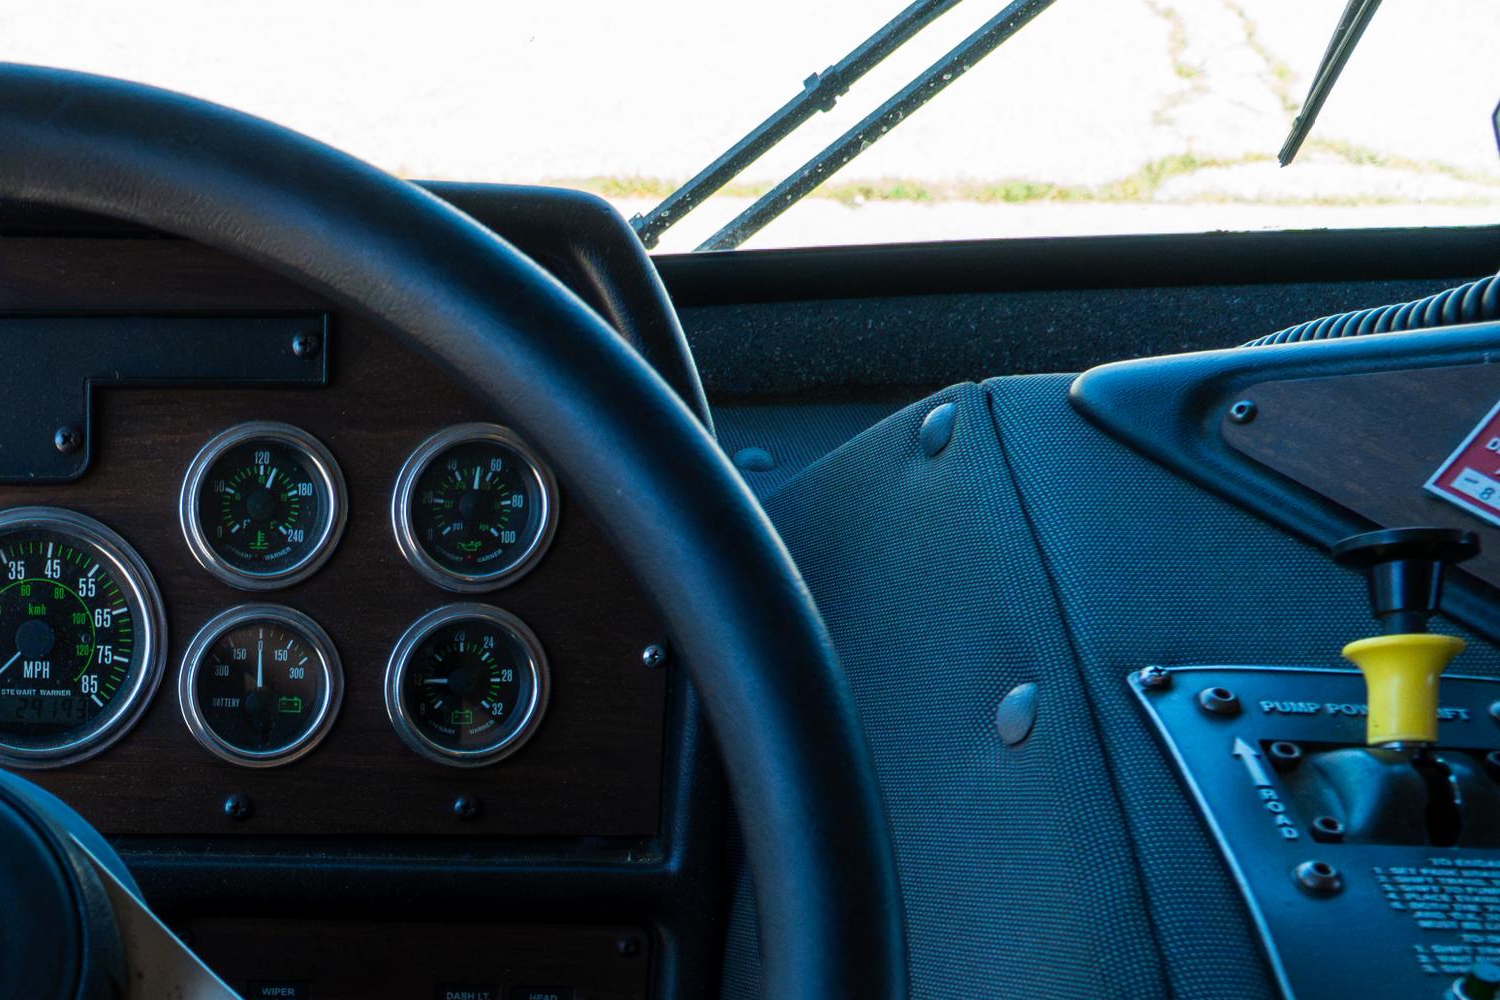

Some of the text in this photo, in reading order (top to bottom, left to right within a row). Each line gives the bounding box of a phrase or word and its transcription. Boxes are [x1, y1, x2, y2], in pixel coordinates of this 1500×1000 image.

[254, 451, 270, 465] 120
[490, 458, 502, 472] 60
[297, 482, 313, 496] 180
[511, 494, 523, 508] 80
[287, 529, 304, 543] 240
[500, 530, 516, 544] 100
[8, 561, 25, 580] 35
[44, 559, 61, 579] 45
[20, 585, 31, 597] 60
[54, 587, 65, 599] 80
[78, 578, 96, 598] 55
[28, 604, 47, 616] kmh
[72, 613, 86, 625] 100
[94, 609, 111, 628] 65
[258, 639, 264, 651] 0
[483, 635, 494, 649] 24
[76, 644, 89, 656] 120
[96, 645, 113, 665] 75
[233, 648, 247, 660] 150
[274, 649, 288, 662] 150
[23, 661, 50, 679] MPH
[214, 665, 229, 677] 300
[288, 667, 304, 680] 300
[500, 669, 514, 682] 28
[81, 675, 98, 694] 85
[1, 688, 71, 697] STEWART WARNER
[212, 697, 240, 708] BATTERY
[492, 702, 504, 716] 32
[1259, 700, 1320, 714] PUMP
[1258, 787, 1299, 839] ROAD
[261, 987, 296, 997] WIPER
[446, 991, 491, 1000] DASH LT.
